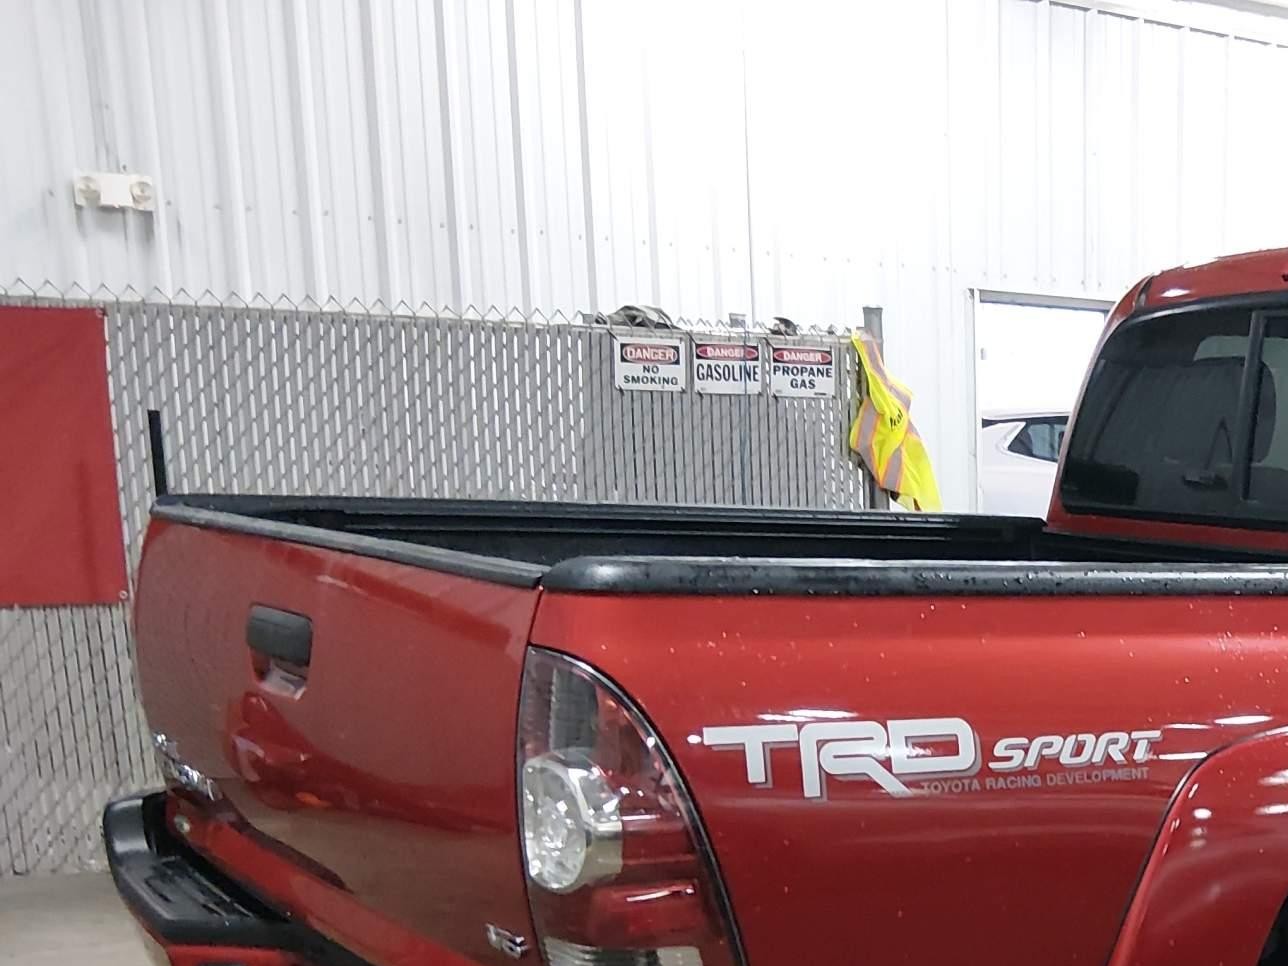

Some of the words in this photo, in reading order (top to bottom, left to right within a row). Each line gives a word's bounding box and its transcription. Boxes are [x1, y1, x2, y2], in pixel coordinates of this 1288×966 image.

[627, 346, 674, 360] DANGER
[783, 351, 822, 363] DANGER
[643, 365, 660, 374] NO
[696, 363, 760, 382] GASOLINE
[773, 365, 833, 378] PROPANE
[624, 375, 679, 386] SMOKING
[790, 379, 816, 389] GAS
[703, 716, 979, 798] TRD
[987, 729, 1162, 771] SPORT
[921, 779, 981, 793] TOYOTA
[986, 774, 1041, 789] RACING
[1047, 767, 1150, 785] DEVELOPMENT
